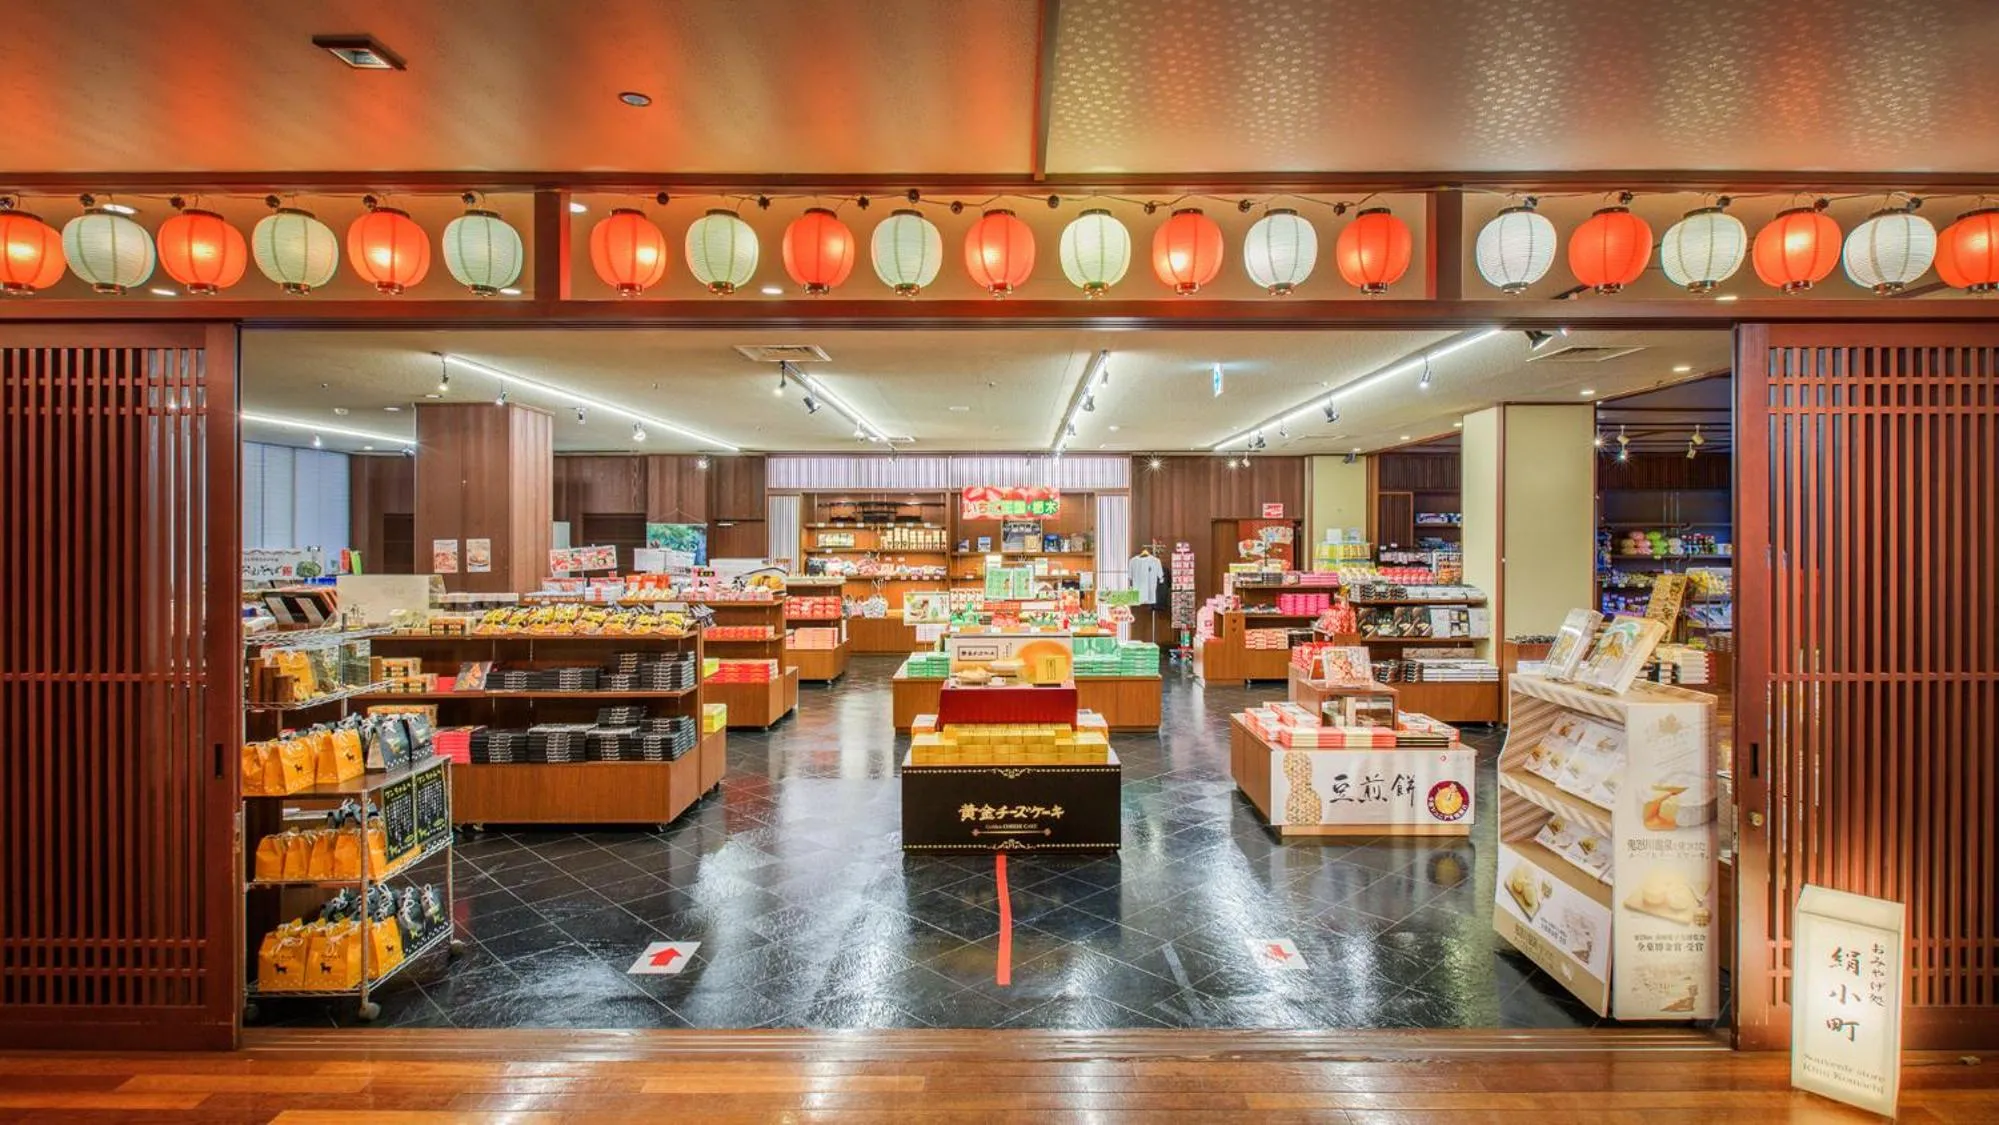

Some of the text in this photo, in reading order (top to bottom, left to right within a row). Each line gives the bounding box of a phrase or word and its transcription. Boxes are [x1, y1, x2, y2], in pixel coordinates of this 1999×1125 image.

[958, 803, 1065, 822] 黄金チーズケーキ
[1329, 773, 1416, 808] 豆煎餅
[1826, 946, 1861, 1042] 絹小町
[1869, 943, 1886, 1007] おみやげ処
